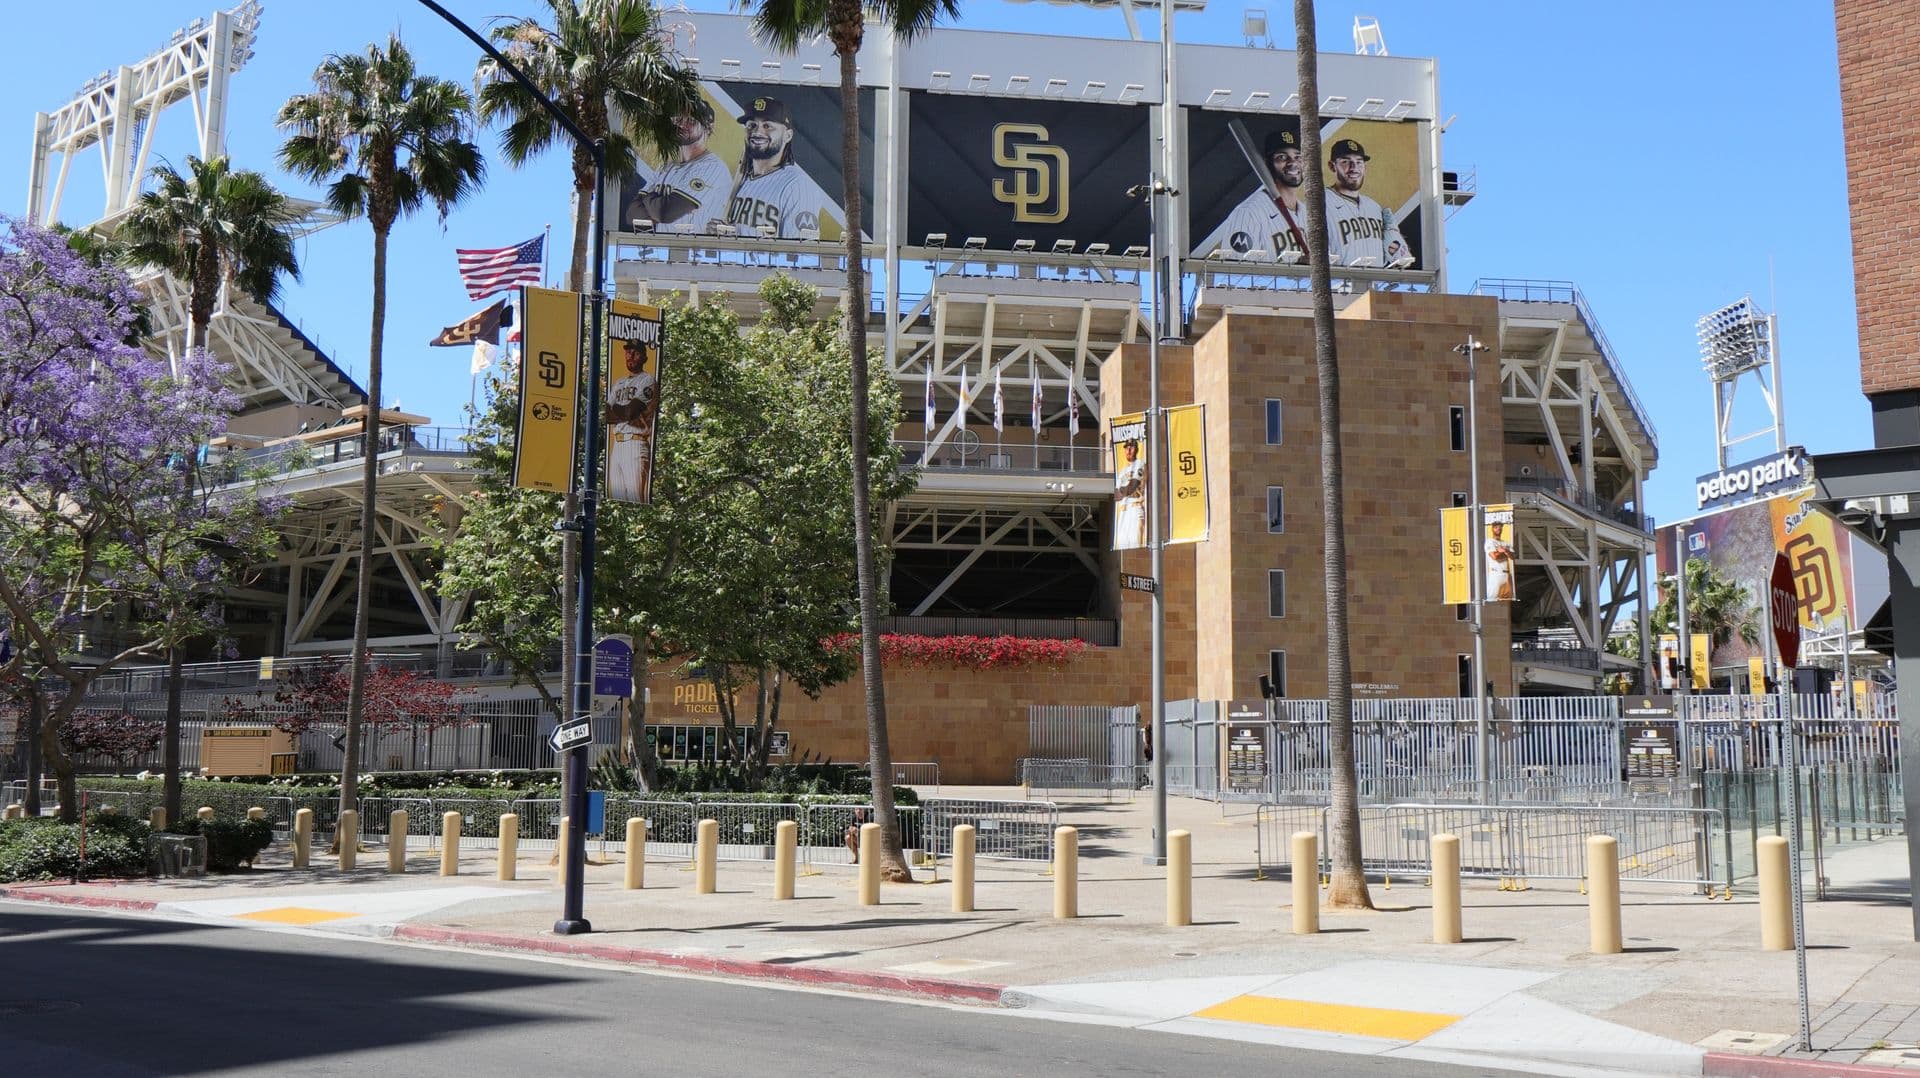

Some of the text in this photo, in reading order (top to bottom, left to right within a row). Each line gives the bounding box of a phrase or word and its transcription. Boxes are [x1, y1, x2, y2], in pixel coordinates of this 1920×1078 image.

[609, 315, 661, 346] MUSGROVE
[1696, 452, 1800, 510] petco park
[1772, 587, 1799, 634] STOP
[574, 724, 588, 738] WAY
